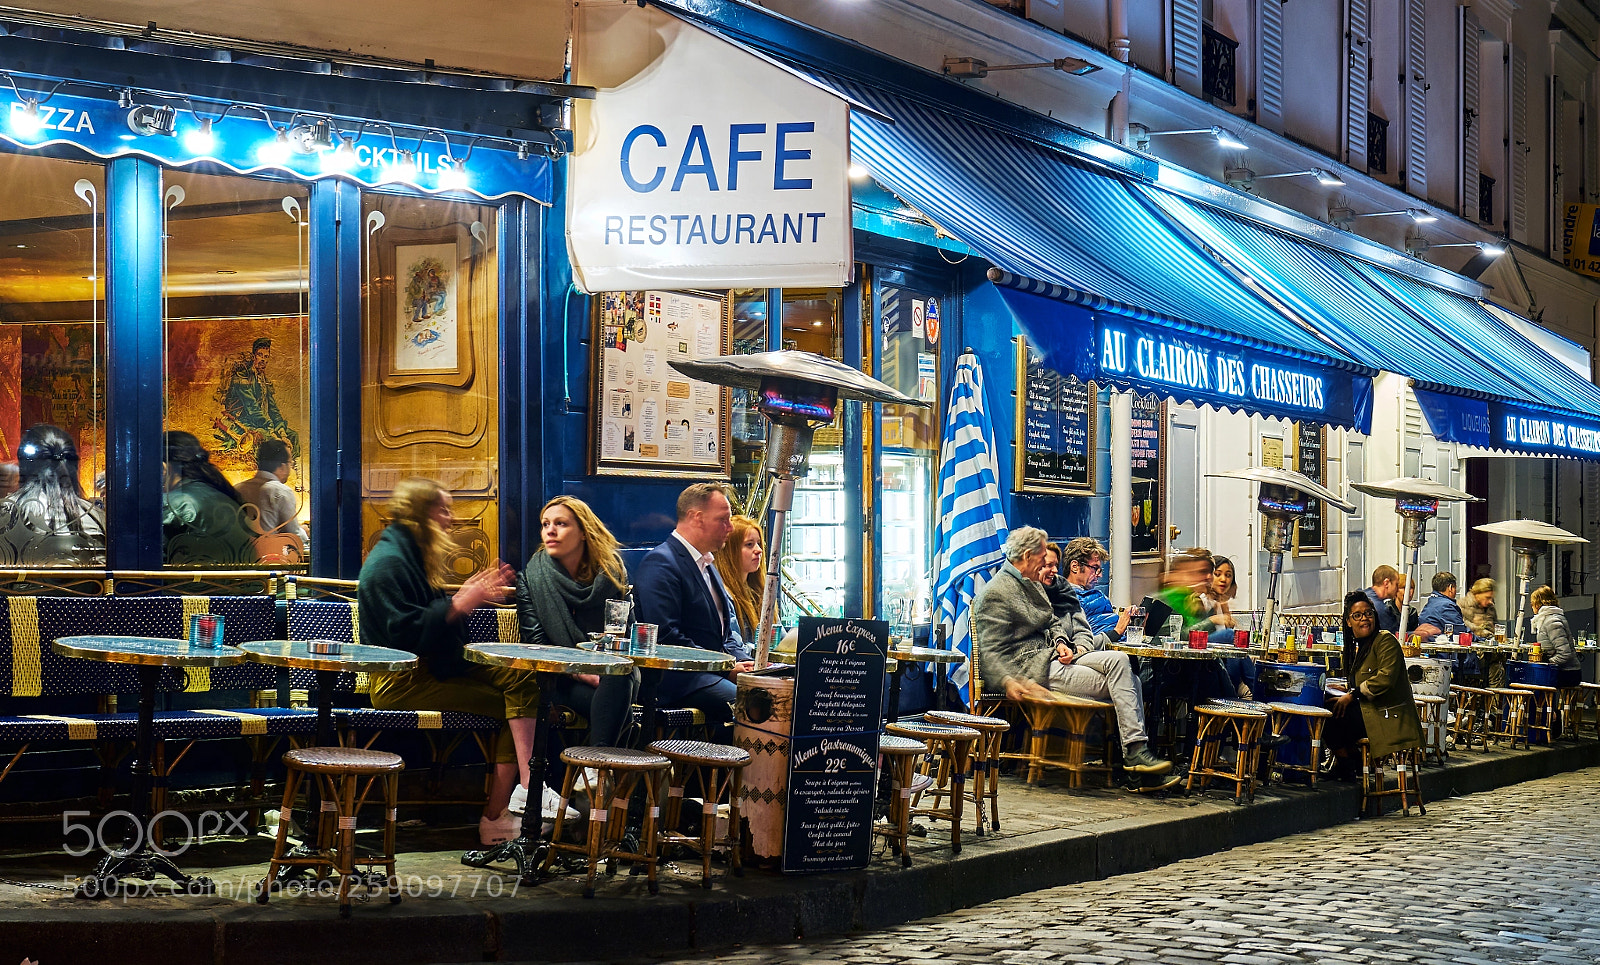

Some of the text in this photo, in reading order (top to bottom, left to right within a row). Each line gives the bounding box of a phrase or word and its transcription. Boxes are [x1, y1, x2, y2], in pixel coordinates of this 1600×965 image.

[620, 122, 815, 193] CAFE
[604, 212, 825, 245] RESTAURANT
[1564, 205, 1578, 254] vendre
[1103, 329, 1324, 409] AU CLAIRON DES CHASSEURS
[1462, 413, 1490, 434] LIQUEURS
[1507, 416, 1516, 442] AU
[1520, 418, 1550, 444] CLAIRON
[1552, 422, 1566, 447] DES
[814, 620, 876, 643] Menu Express
[836, 640, 856, 654] 16€
[794, 738, 876, 769] Menu Gastronomique
[825, 759, 846, 773] 22€
[805, 779, 821, 787] Soupe
